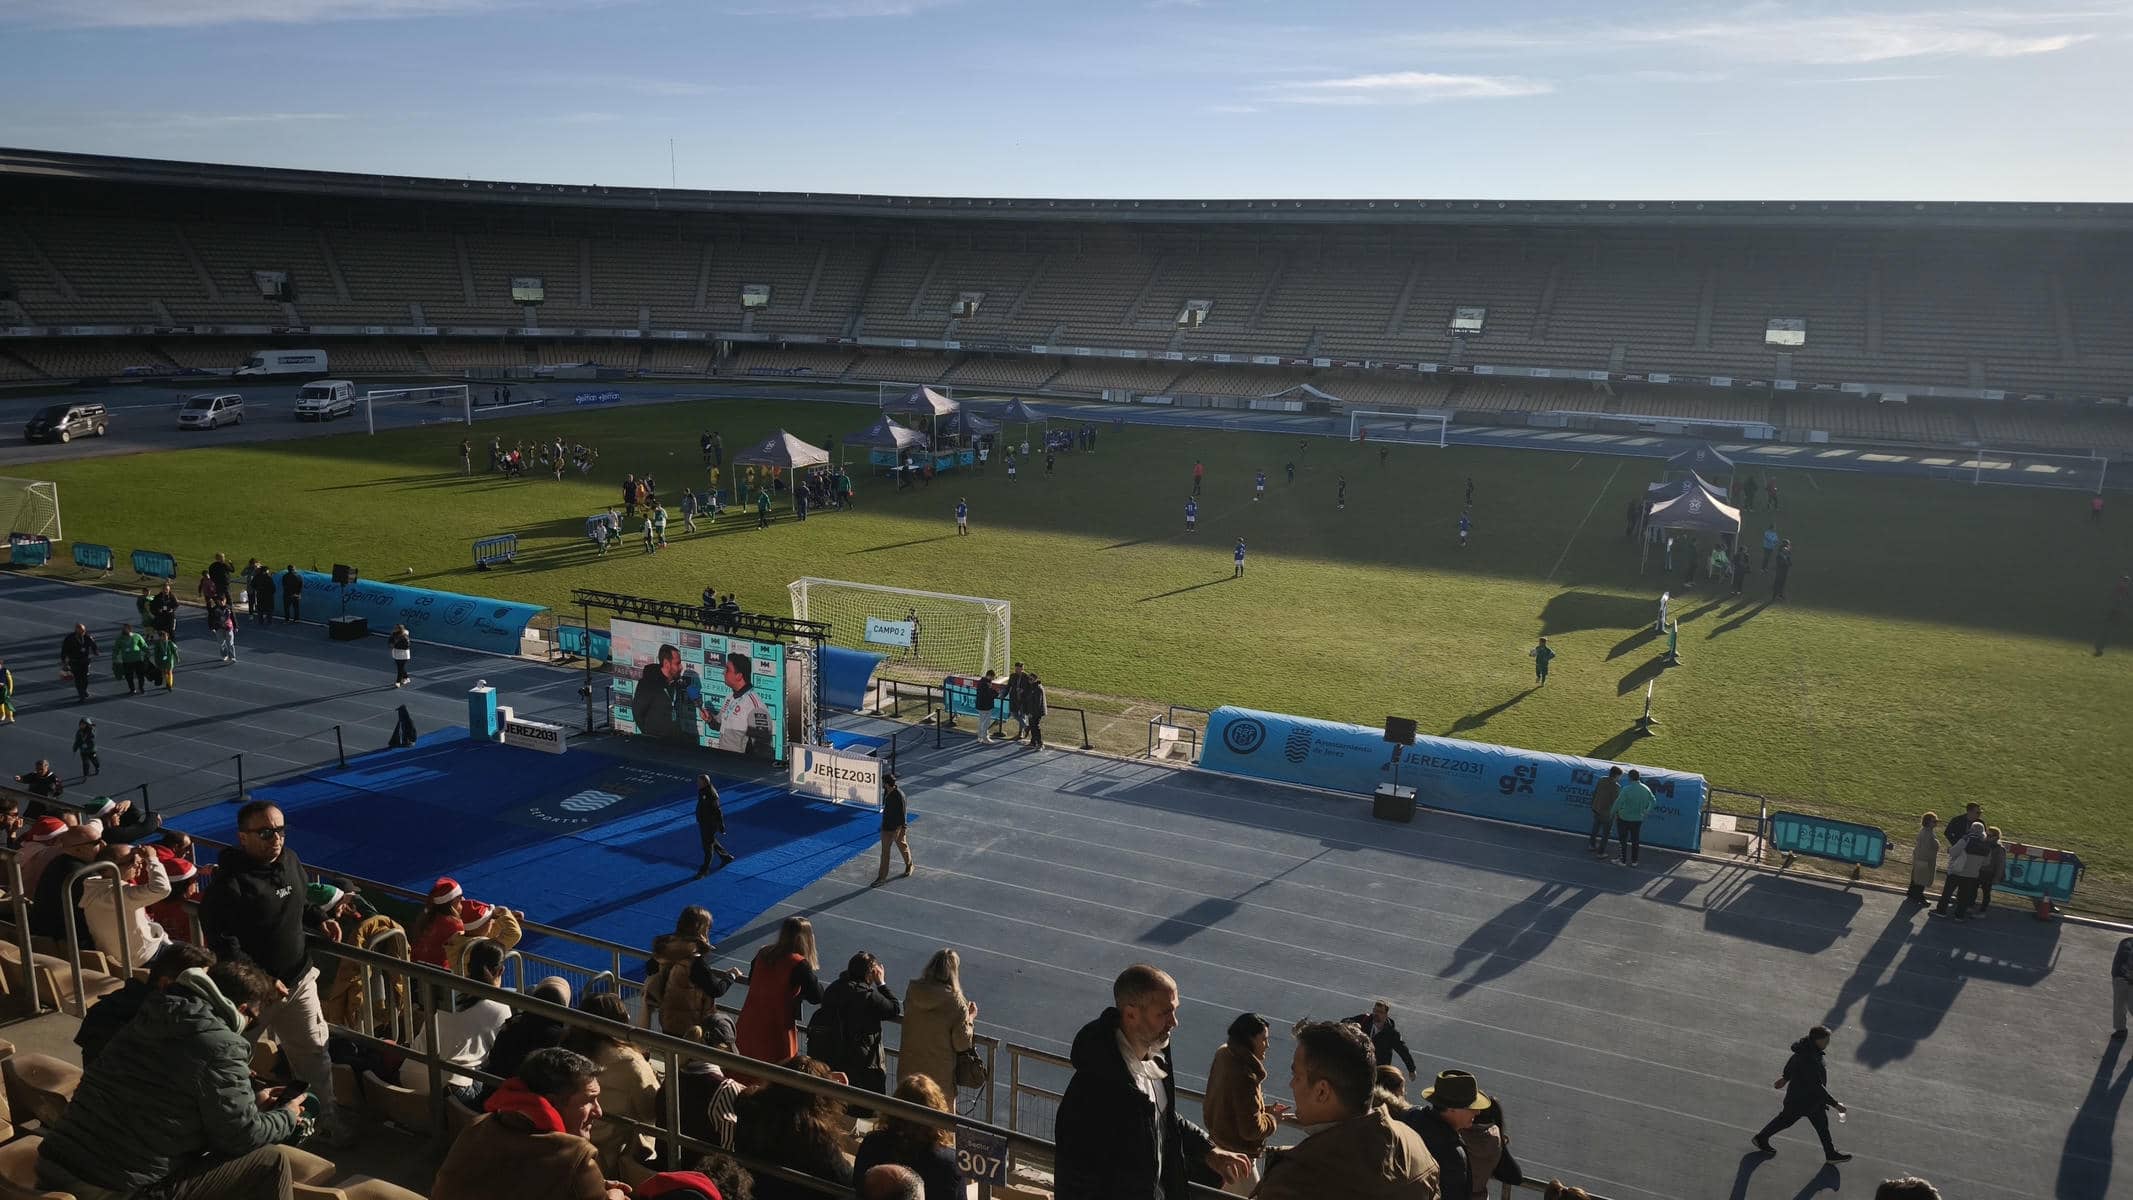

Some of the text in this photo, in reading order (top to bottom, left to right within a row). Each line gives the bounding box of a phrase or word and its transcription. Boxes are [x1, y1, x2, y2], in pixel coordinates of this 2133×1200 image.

[873, 624, 905, 636] CAMPO 2
[505, 724, 558, 742] JEREZ2031
[814, 763, 876, 785] JEREZ2031
[1403, 753, 1484, 776] JEREZ2031
[958, 1150, 1000, 1178] 307
